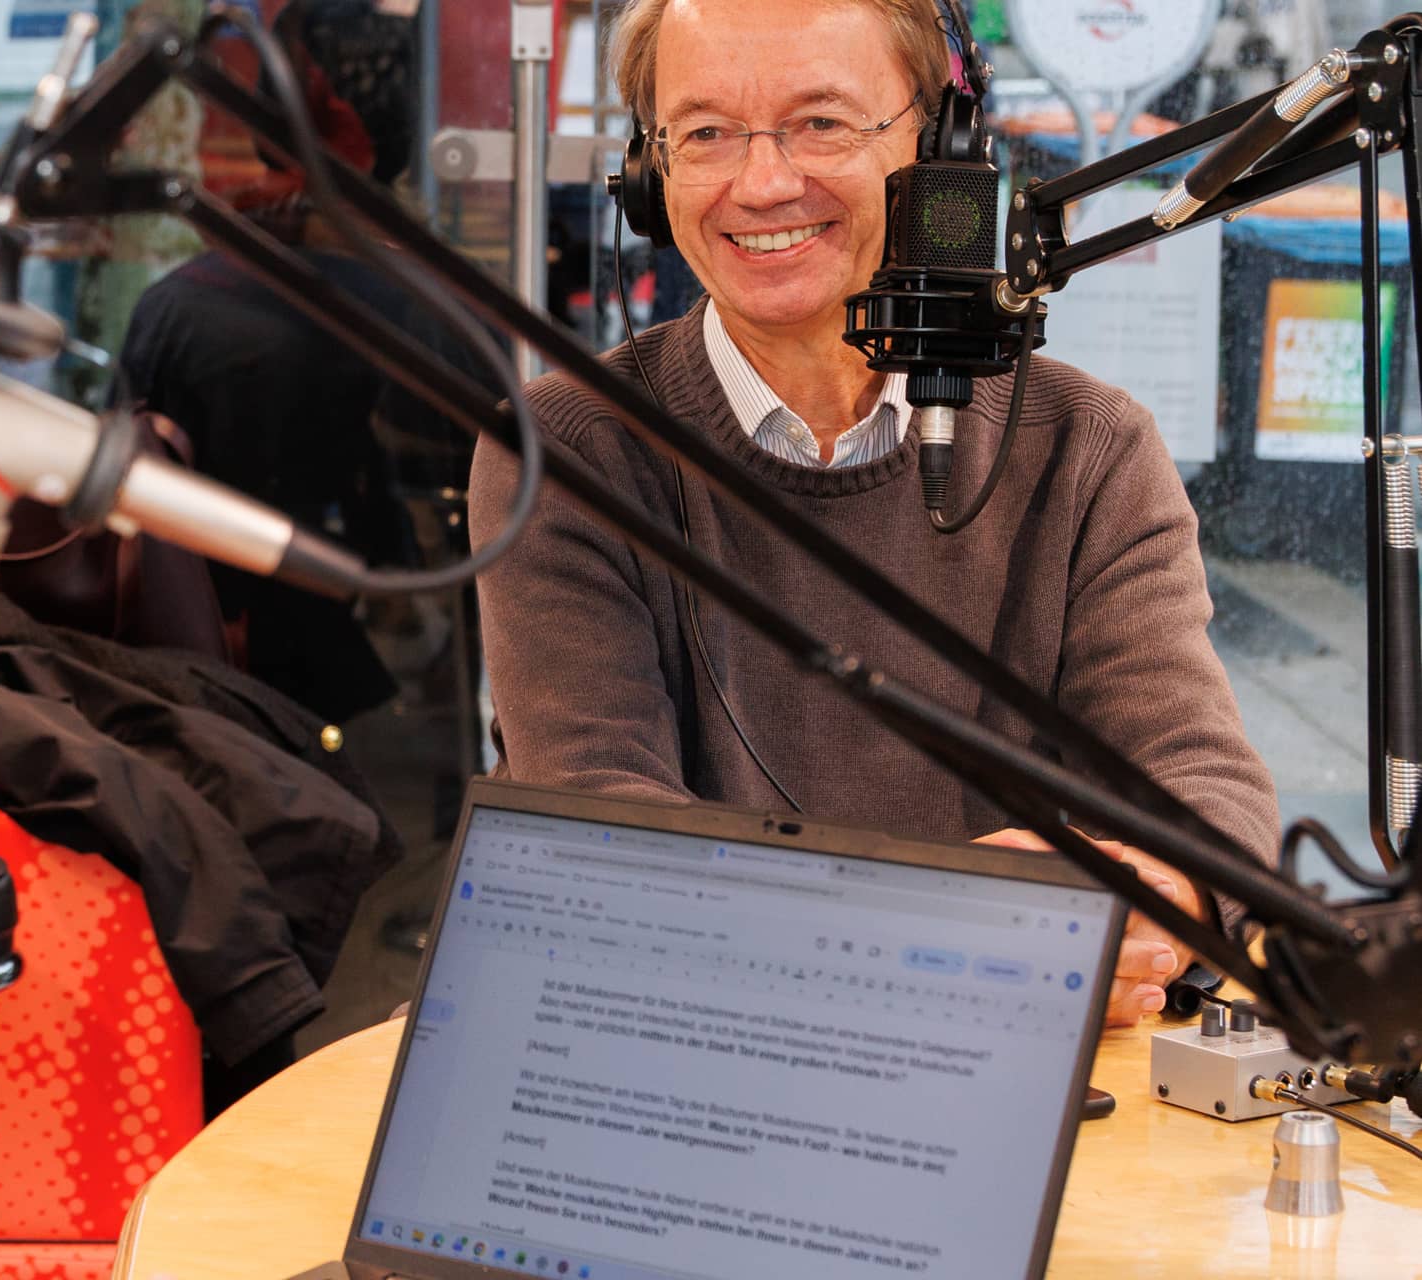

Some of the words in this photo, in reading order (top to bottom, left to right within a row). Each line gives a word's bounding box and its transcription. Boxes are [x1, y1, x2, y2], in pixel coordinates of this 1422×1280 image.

[574, 984, 641, 1003] Musiksommer
[638, 1029, 671, 1042] mitten
[706, 1039, 735, 1053] Stadt
[758, 1050, 787, 1063] eines
[789, 1056, 828, 1068] großen
[511, 1101, 581, 1122] Musiksommer
[596, 1118, 634, 1132] diesem
[636, 1125, 660, 1137] Jahr
[863, 1149, 898, 1163] haben
[563, 1173, 630, 1194] Musiksommer
[487, 1192, 524, 1207] Worauf
[526, 1199, 559, 1214] freuen
[580, 1212, 602, 1223] sich
[525, 1183, 561, 1198] Welche
[564, 1192, 638, 1213] musikalischen
[641, 1206, 694, 1225] Highlights
[698, 1219, 733, 1232] stehen
[802, 1239, 843, 1255] diesem
[845, 1248, 870, 1261] Jahr
[873, 1254, 902, 1267] noch
